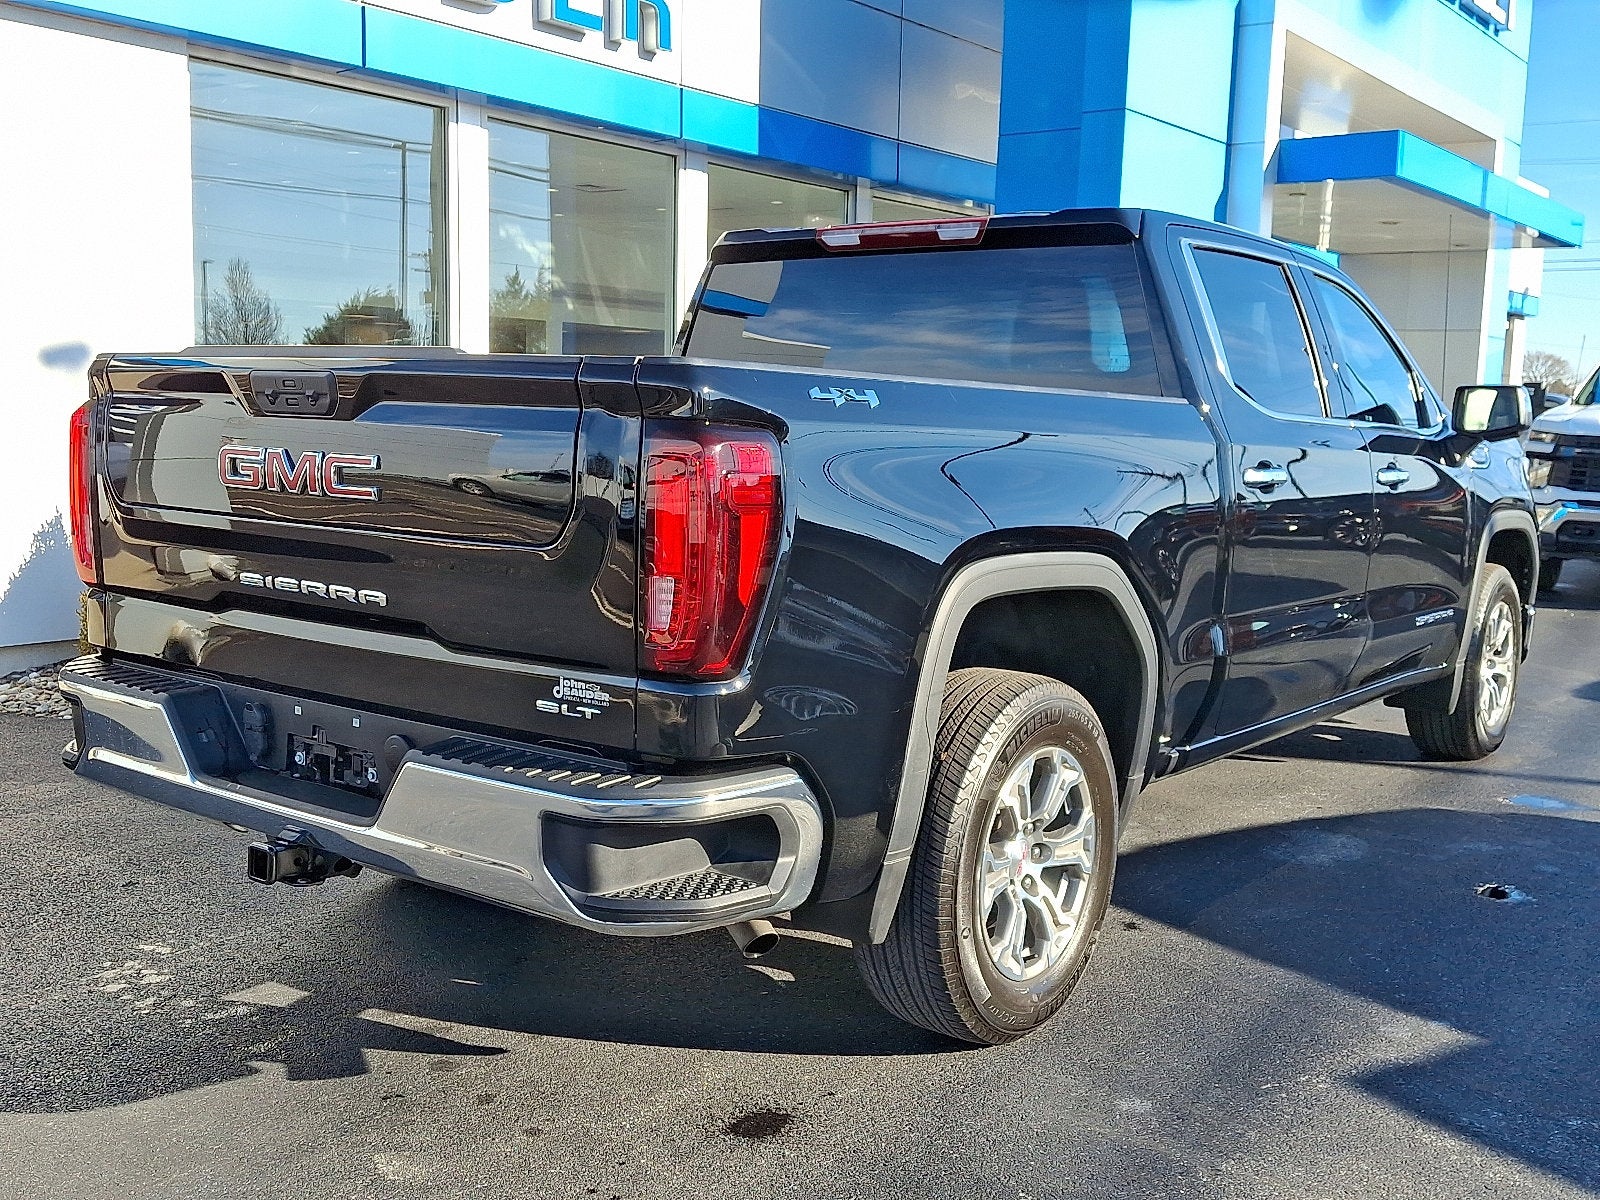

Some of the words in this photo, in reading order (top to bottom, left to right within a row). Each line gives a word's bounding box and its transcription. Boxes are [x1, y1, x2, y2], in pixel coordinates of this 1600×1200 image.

[217, 444, 382, 501] GMC
[239, 572, 388, 607] SIERRA
[563, 687, 610, 702] SAUDER
[536, 699, 601, 719] SLT
